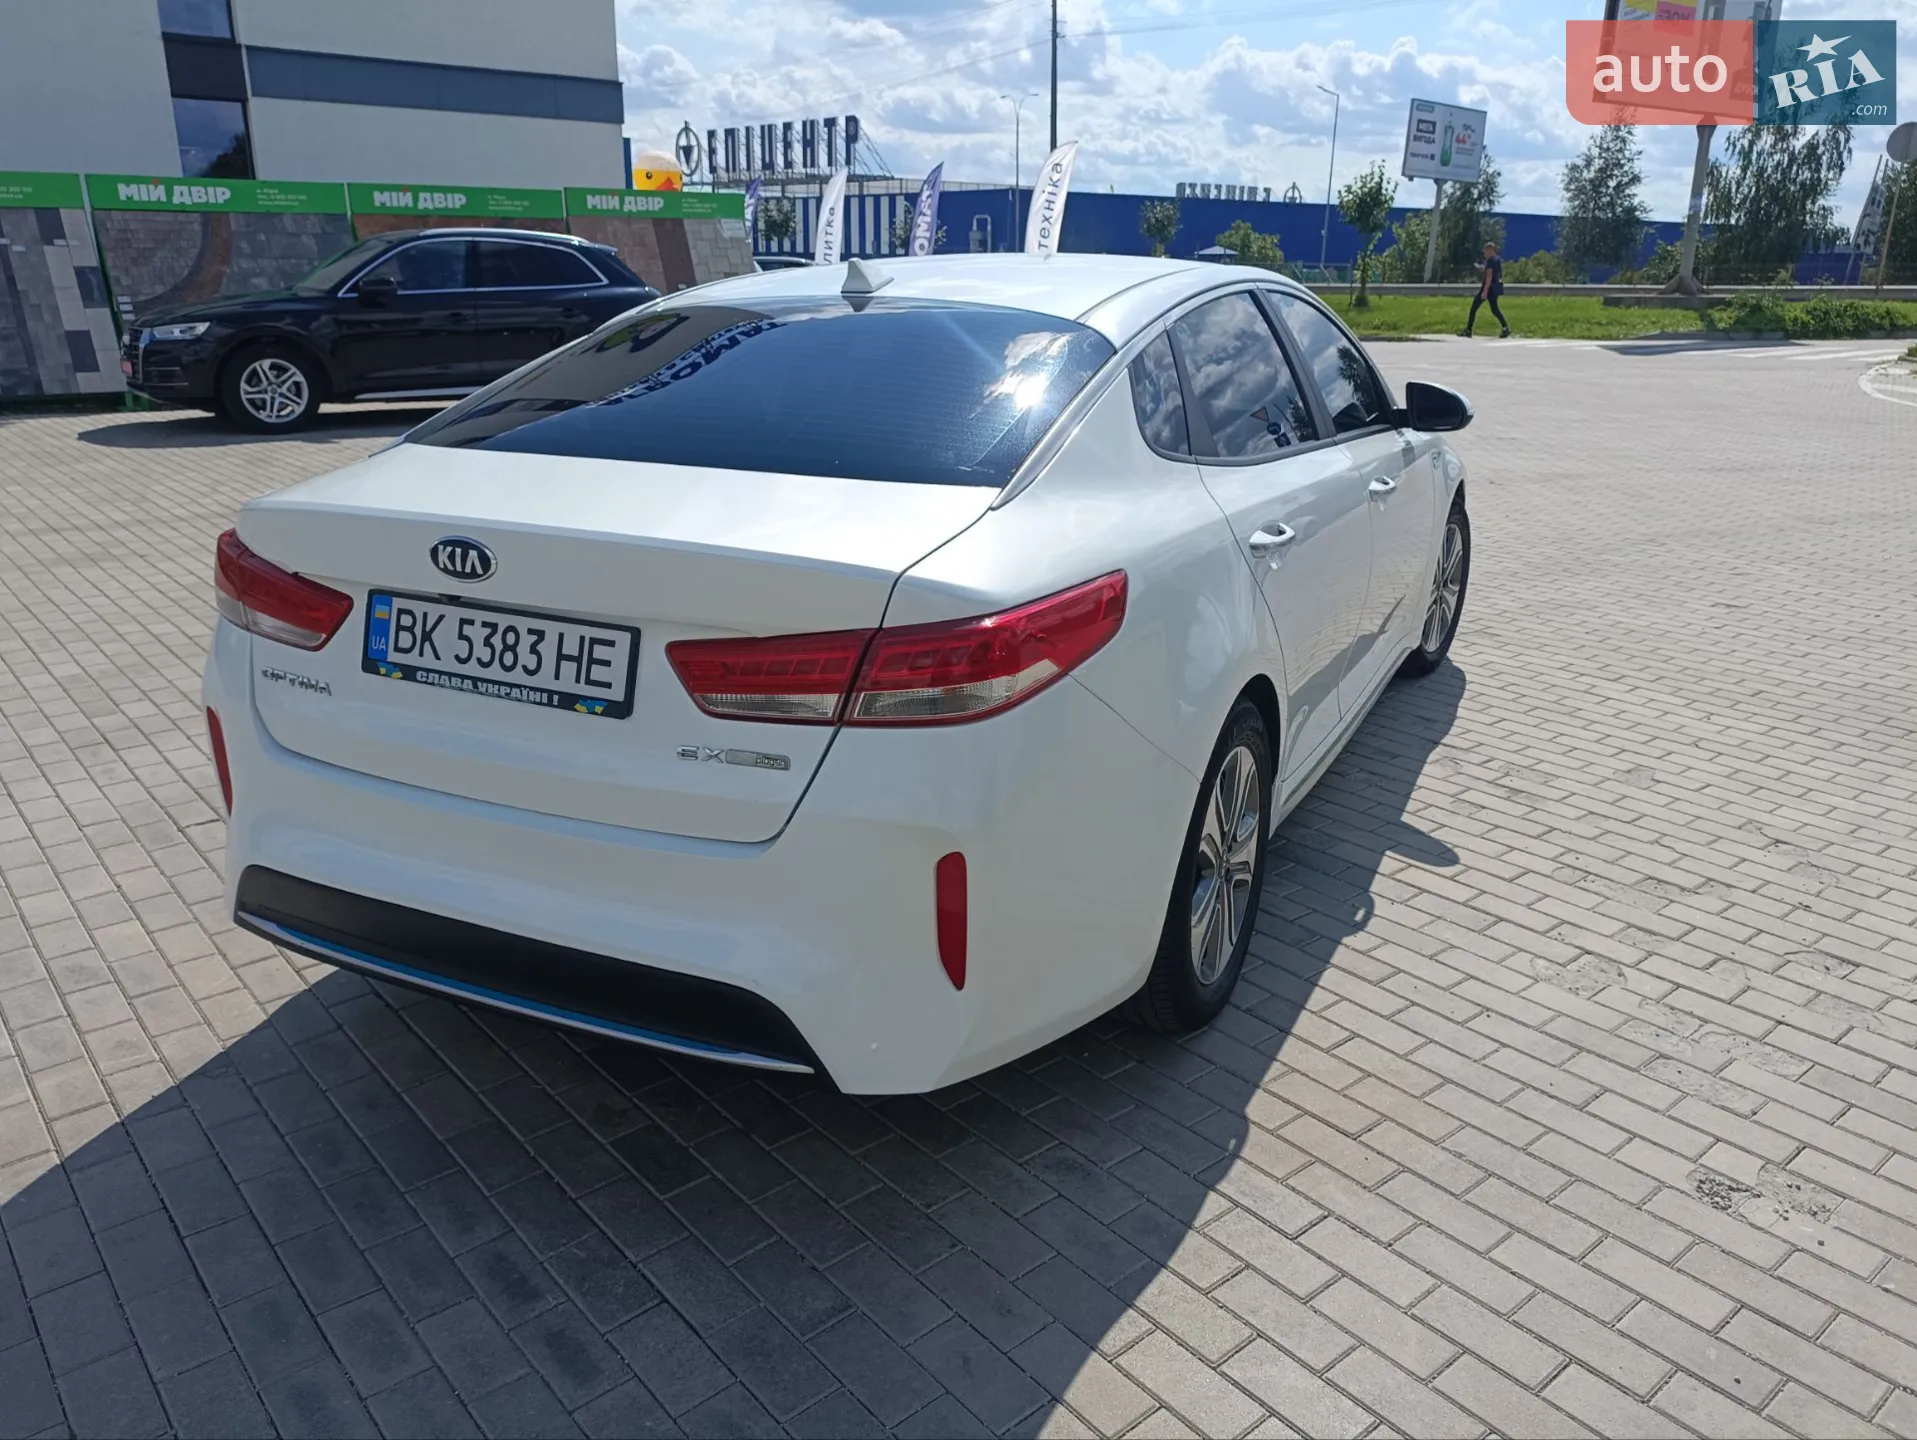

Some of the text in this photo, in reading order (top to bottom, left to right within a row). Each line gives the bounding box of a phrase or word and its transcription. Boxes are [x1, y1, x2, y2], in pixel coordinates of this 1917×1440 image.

[707, 115, 859, 175] ЕПІЦЕНТР
[117, 180, 167, 202] МІЙ
[172, 185, 232, 206] ДВІР
[373, 187, 413, 208] МІЙ
[417, 192, 467, 210] ДВІР
[586, 192, 621, 210] МІЙ
[623, 196, 664, 213] ДВІР
[823, 207, 835, 265] литка
[437, 544, 484, 575] KIA
[371, 634, 387, 652] UA
[393, 607, 616, 690] BK 5383 HE
[415, 670, 474, 692] СЛАВА
[477, 681, 549, 705] УКРАЇНІ
[676, 744, 725, 764] EX
